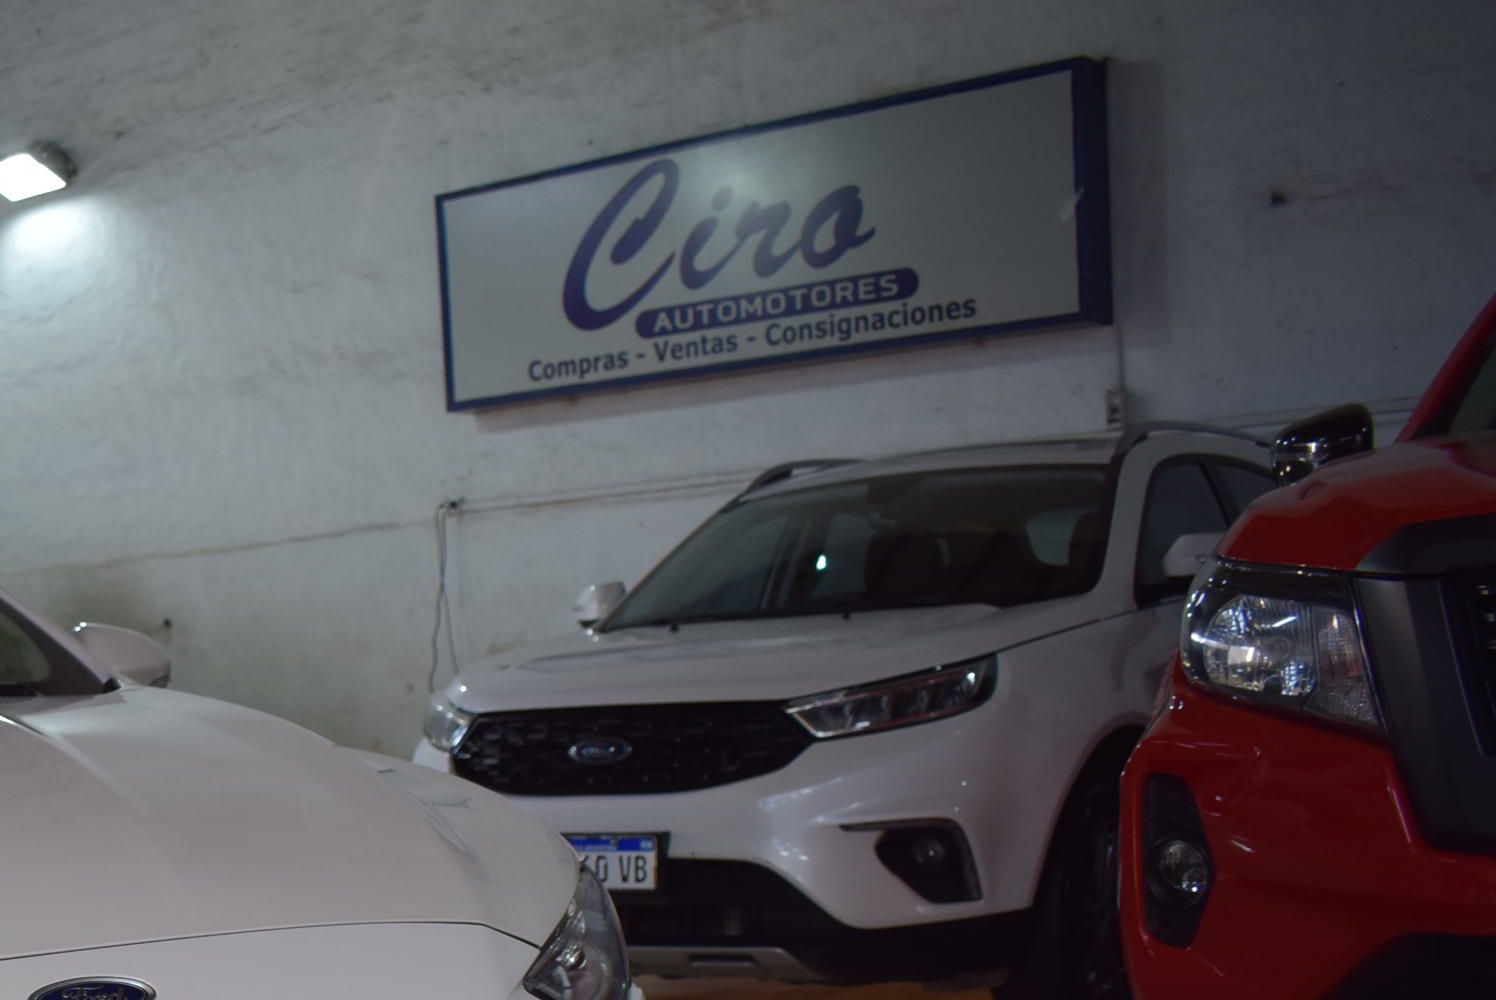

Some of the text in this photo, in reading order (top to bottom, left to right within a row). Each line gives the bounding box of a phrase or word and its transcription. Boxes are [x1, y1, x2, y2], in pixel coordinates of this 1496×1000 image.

[562, 158, 876, 331] Ciro
[527, 349, 630, 383] Compras
[653, 333, 740, 363] Ventas
[764, 297, 978, 347] Consignaciones
[653, 273, 900, 334] AUTOMOTORES
[618, 854, 648, 883] VB
